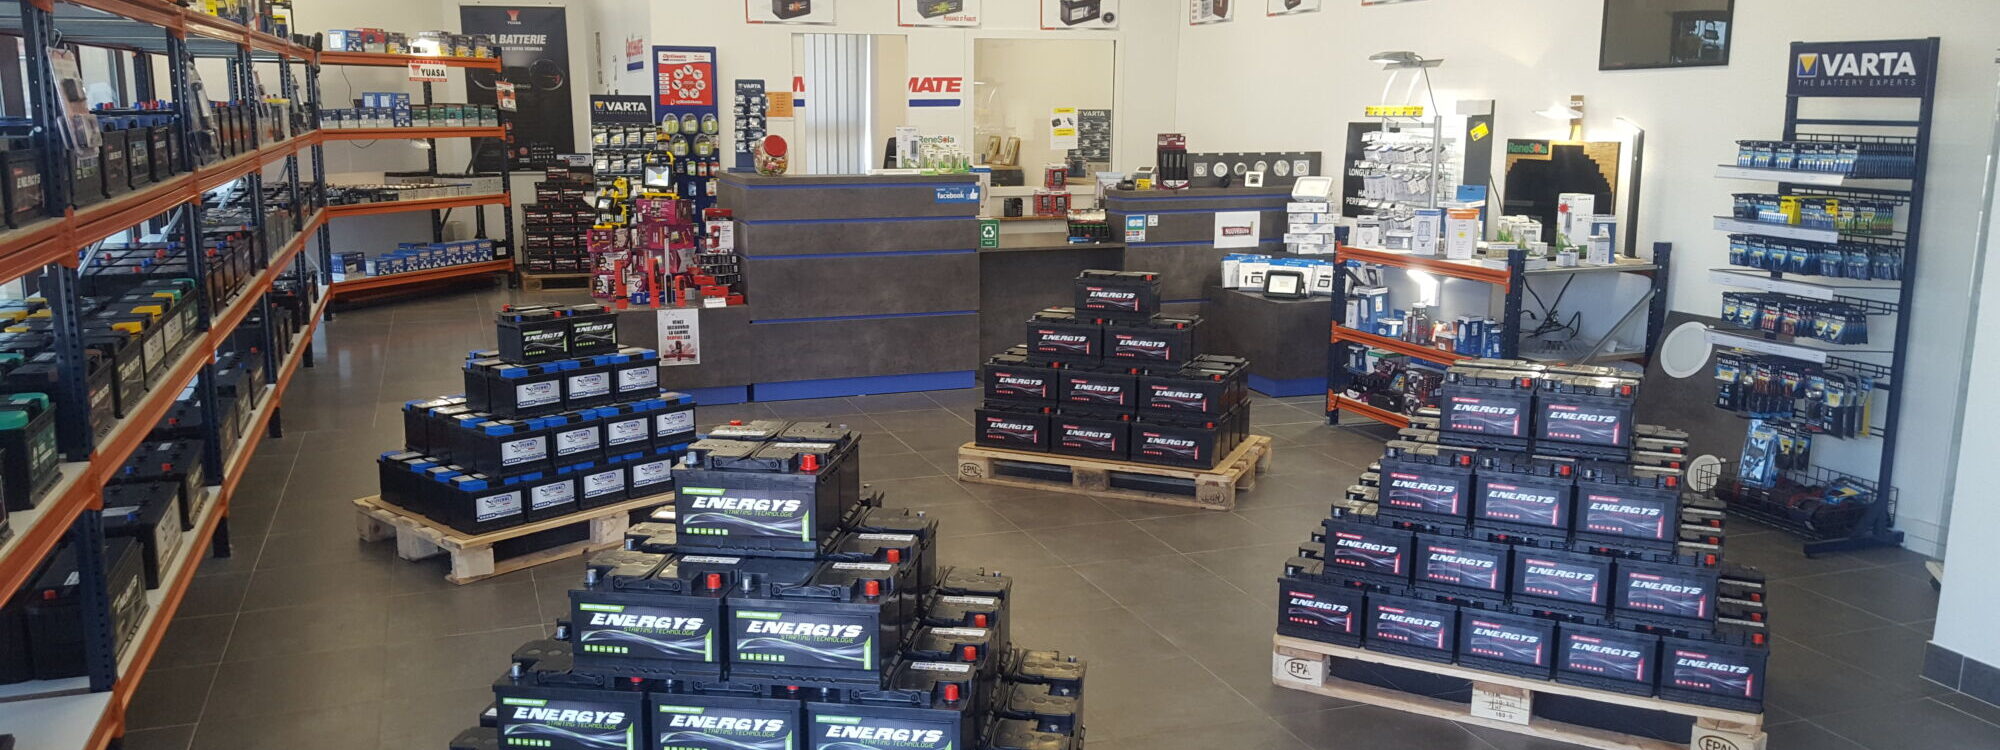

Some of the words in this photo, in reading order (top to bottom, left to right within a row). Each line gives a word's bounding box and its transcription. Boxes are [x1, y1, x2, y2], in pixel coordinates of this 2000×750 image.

[499, 34, 547, 44] BATTERIE
[1822, 52, 1916, 76] VARTA
[421, 68, 445, 76] YUASA
[605, 102, 647, 112] VARTA
[576, 323, 613, 332] ENERGYS
[525, 331, 564, 341] ENERGYS
[1120, 340, 1165, 348] ENERGYS
[999, 377, 1042, 386] ENERGYS
[1075, 384, 1120, 392] ENERGYS
[1155, 390, 1202, 399] ENERGYS
[1453, 403, 1516, 415] ENERGYS
[1548, 410, 1616, 422] ENERGYS
[991, 422, 1034, 431] ENERGYS
[1067, 429, 1112, 439] ENERGYS
[1147, 437, 1194, 446] ENERGYS
[1390, 479, 1454, 492] ENERGYS
[692, 496, 800, 512] ENERGYS
[1487, 489, 1554, 504] ENERGYS
[1589, 502, 1661, 517] ENERGYS
[1337, 539, 1397, 554] ENERGYS
[1430, 552, 1494, 568] ENERGYS
[1526, 566, 1594, 581] ENERGYS
[1630, 579, 1702, 594] ENERGYS
[1290, 597, 1348, 613] ENERGYS
[590, 613, 704, 630] ENERGYS
[1379, 612, 1440, 627] ENERGYS
[746, 621, 864, 638] ENERGYS
[1472, 627, 1538, 643] ENERGYS
[1571, 642, 1640, 658] ENERGYS
[1677, 658, 1749, 674] ENERGYS
[513, 707, 625, 724] ENERGYS
[670, 714, 784, 732] ENERGYS
[826, 725, 944, 742] ENERGYS
